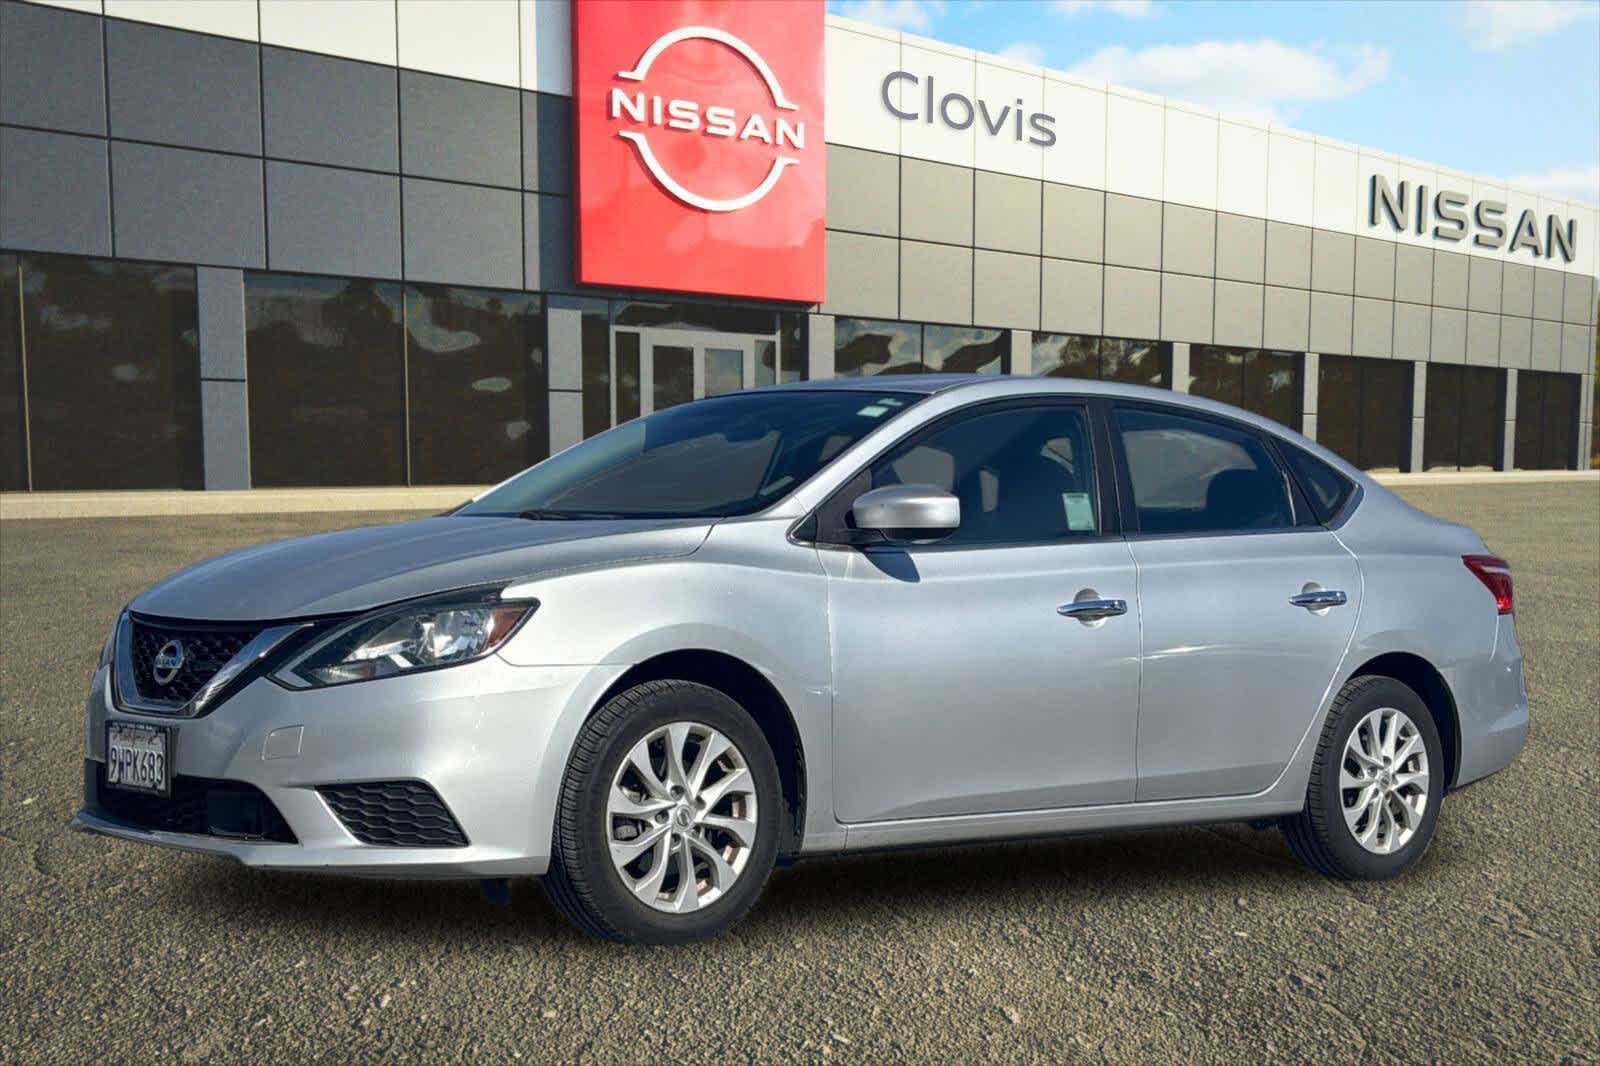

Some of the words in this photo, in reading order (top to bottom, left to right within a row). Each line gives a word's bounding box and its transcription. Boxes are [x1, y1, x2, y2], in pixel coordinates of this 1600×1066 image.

[610, 87, 805, 149] NISSAN
[882, 71, 1057, 147] Clovis
[1369, 174, 1577, 263] NISSAN
